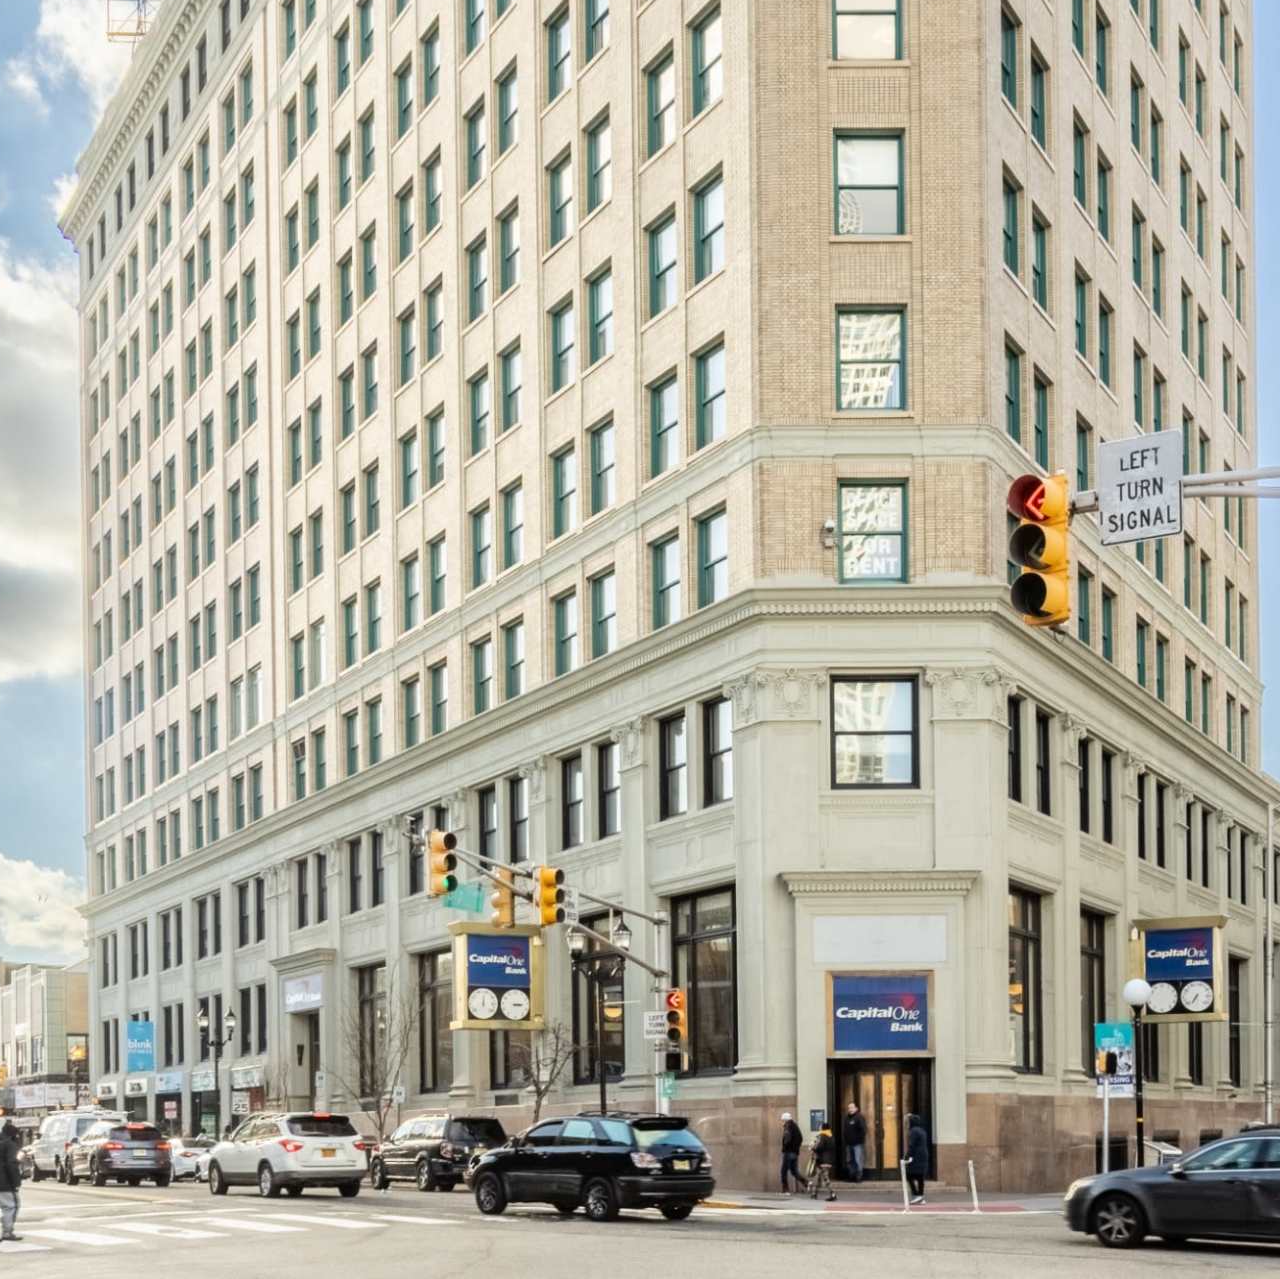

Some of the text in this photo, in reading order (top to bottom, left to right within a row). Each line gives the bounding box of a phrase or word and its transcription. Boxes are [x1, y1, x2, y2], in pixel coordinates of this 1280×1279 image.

[1120, 447, 1160, 472] LEFT
[1116, 477, 1163, 502] TURN
[1108, 505, 1177, 533] SIGNAL
[890, 1022, 923, 1032] Bank
[128, 1038, 152, 1049] blink
[232, 1103, 248, 1113] 25
